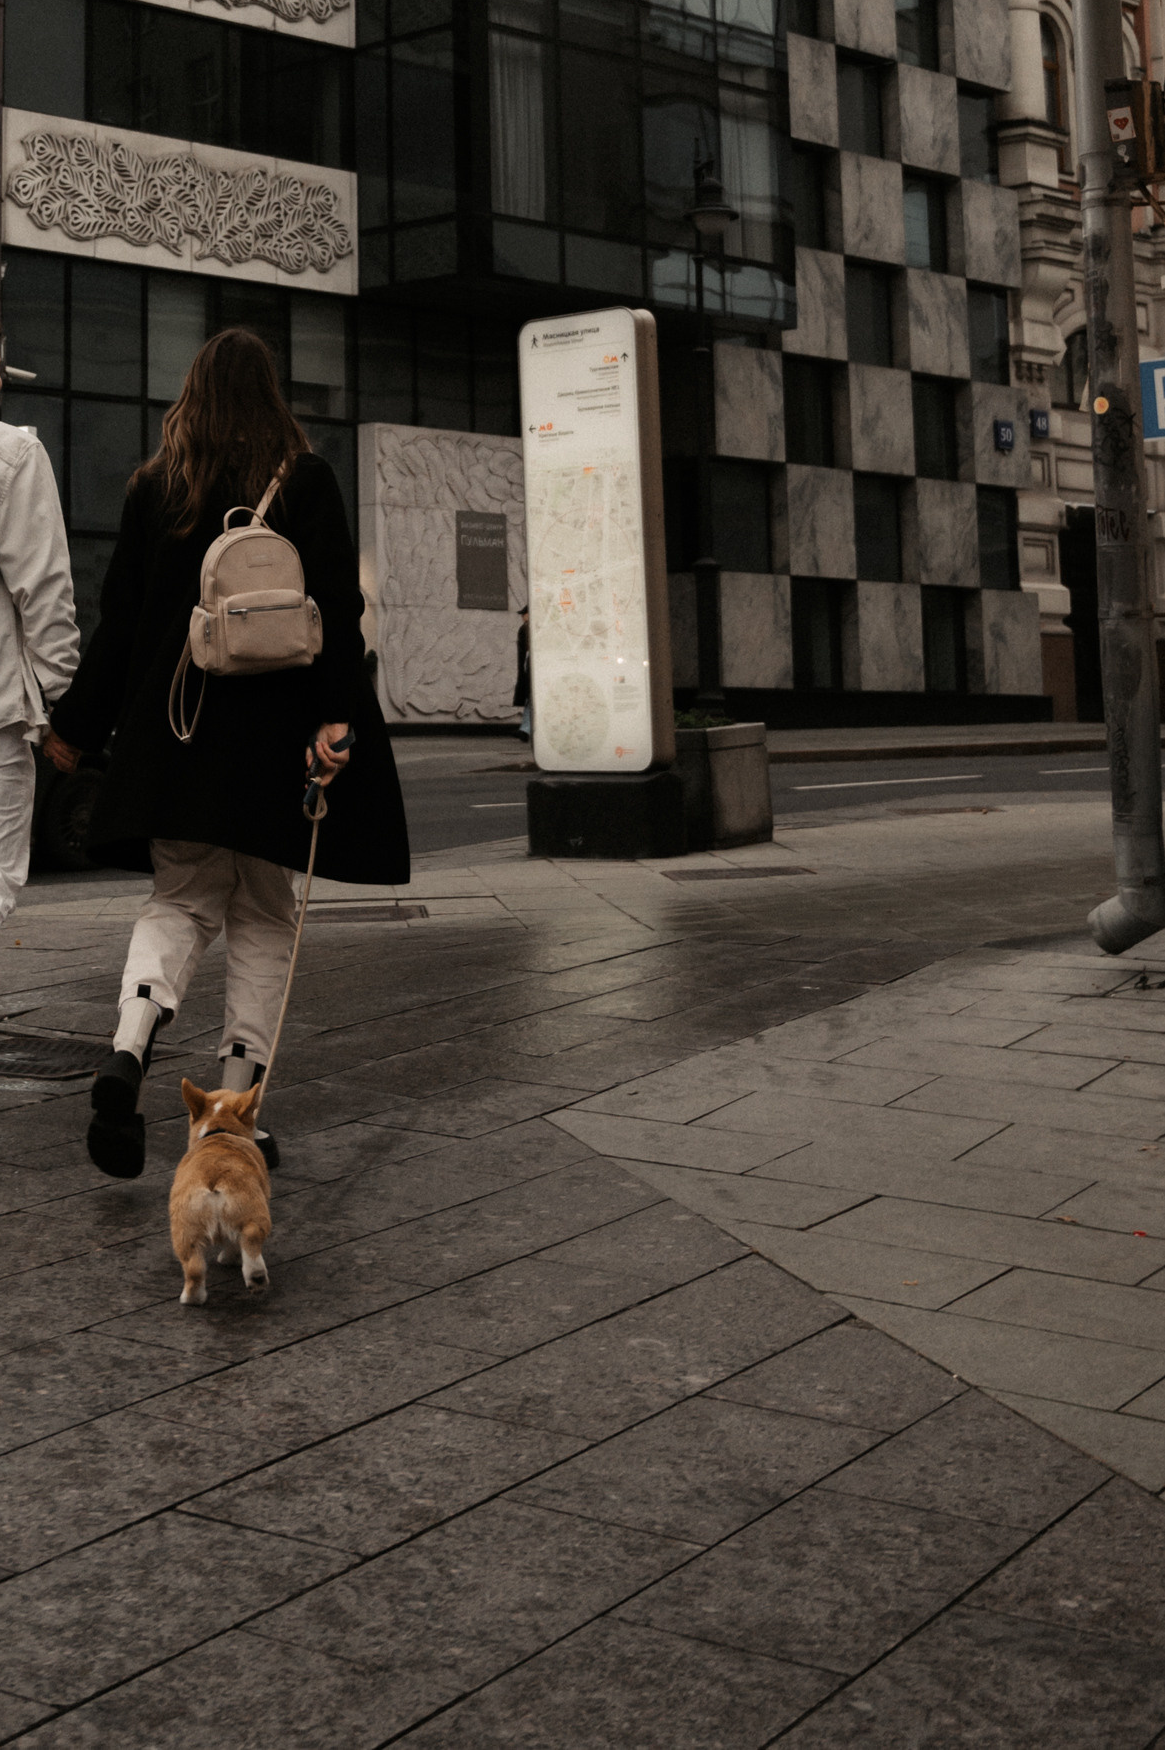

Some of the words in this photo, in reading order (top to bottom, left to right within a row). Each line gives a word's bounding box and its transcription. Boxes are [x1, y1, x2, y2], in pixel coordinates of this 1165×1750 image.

[1036, 417, 1047, 430] 48
[1000, 427, 1012, 442] 50
[460, 534, 504, 547] ГУЛЬМАН
